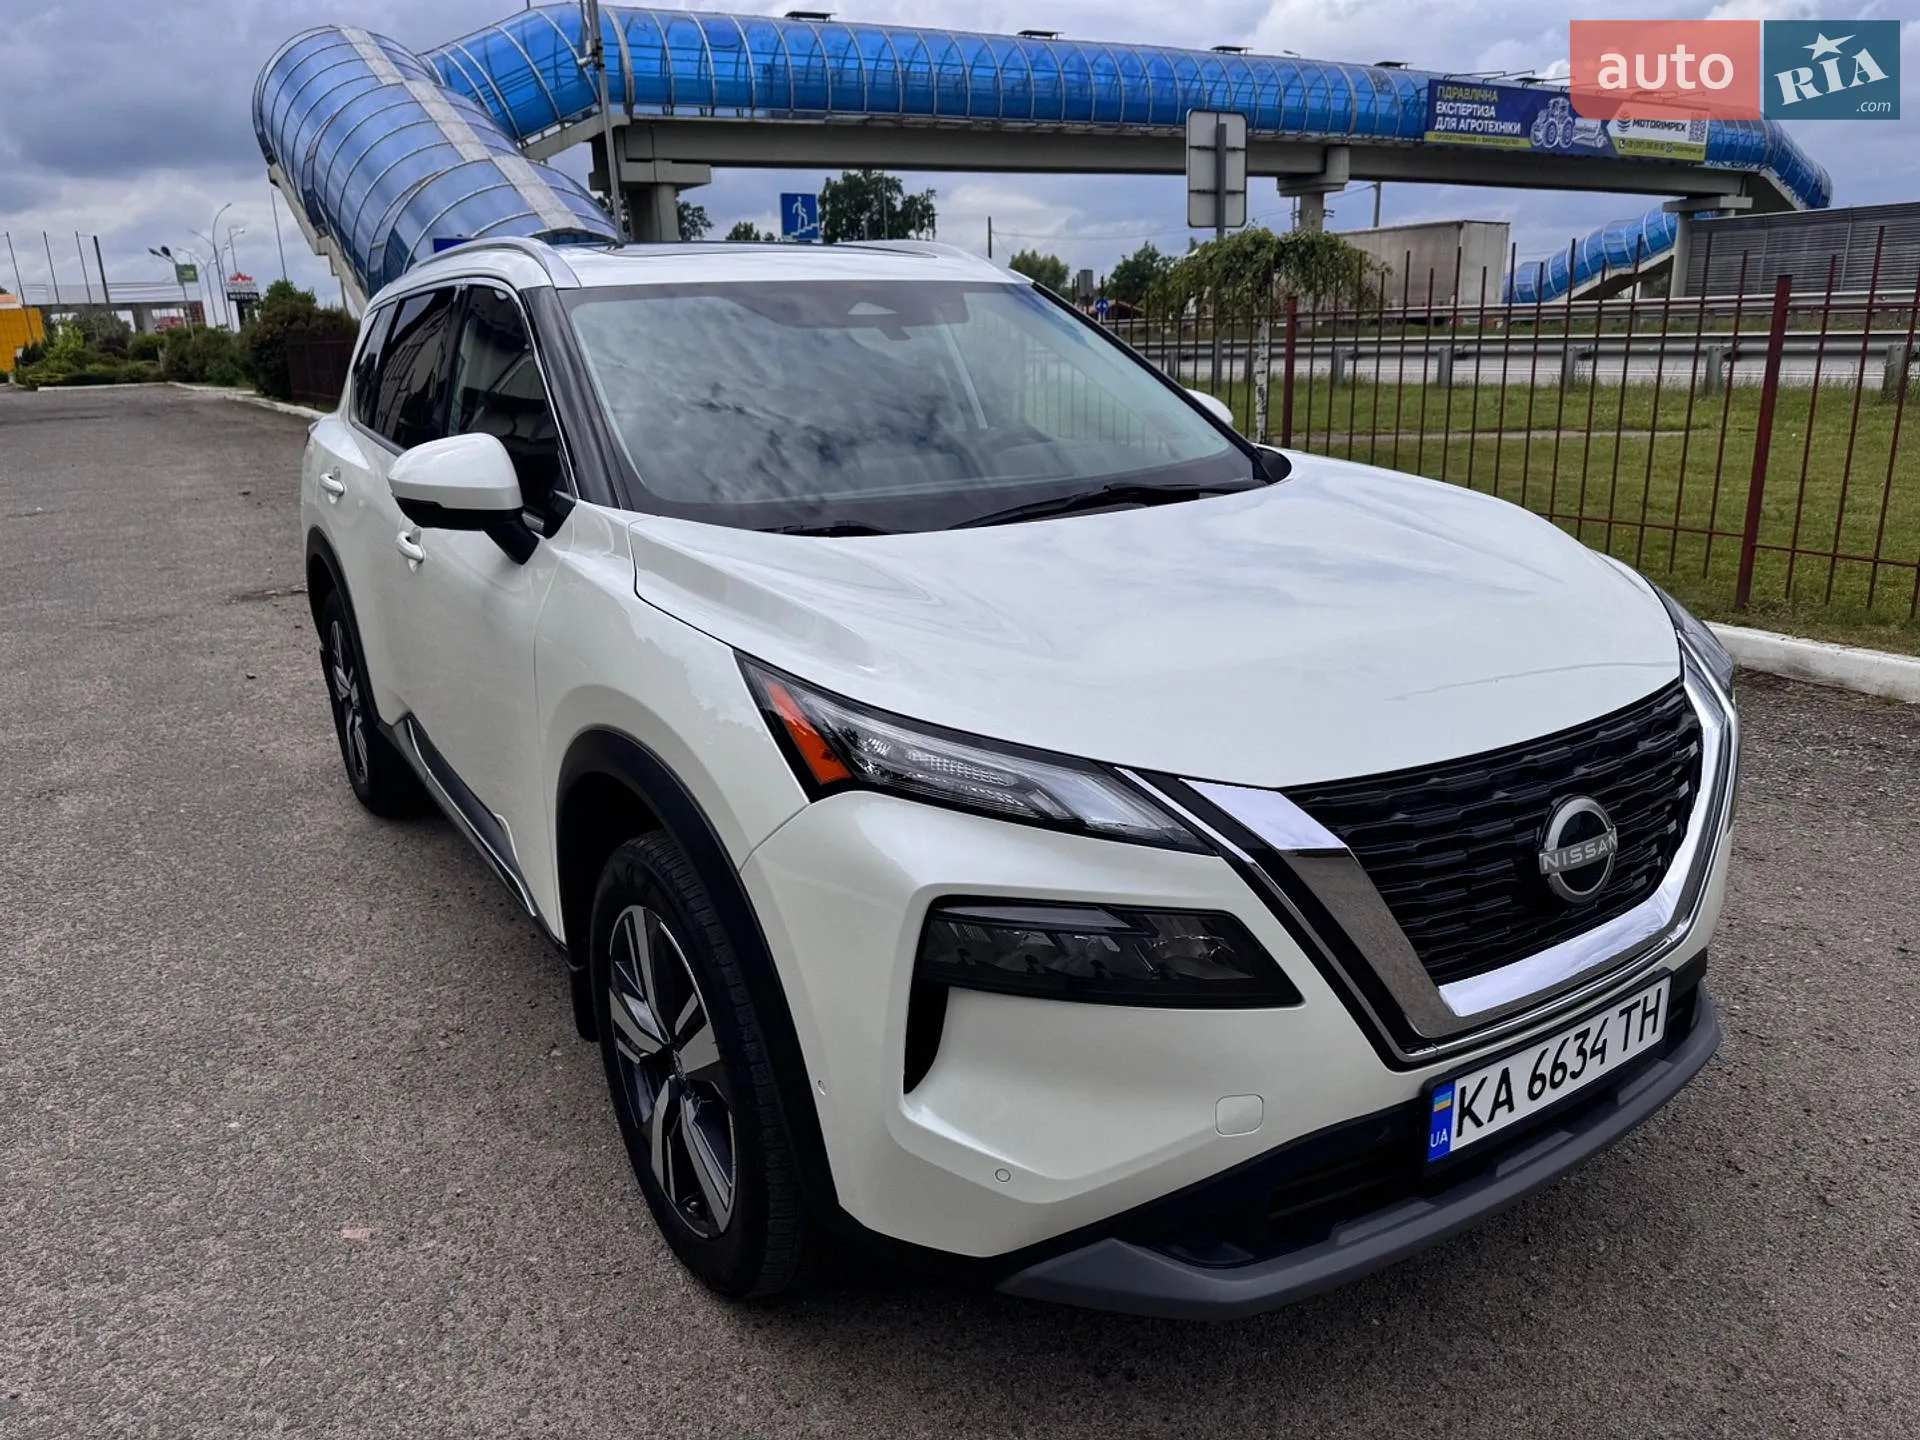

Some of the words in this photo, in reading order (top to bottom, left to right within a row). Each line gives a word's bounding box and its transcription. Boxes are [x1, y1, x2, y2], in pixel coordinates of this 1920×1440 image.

[1436, 101, 1496, 118] ЕКСПЕРТИЗА
[1435, 116, 1457, 131] ДЛЯ
[1458, 118, 1521, 134] АГРОТЕХНІКИ
[1632, 119, 1687, 132] MOTORIMPEX
[1542, 835, 1617, 871] NISSAN
[1456, 1066, 1515, 1138] KA
[1527, 1017, 1610, 1101] 6634
[1618, 987, 1663, 1052] TH
[1430, 1127, 1449, 1148] UA
